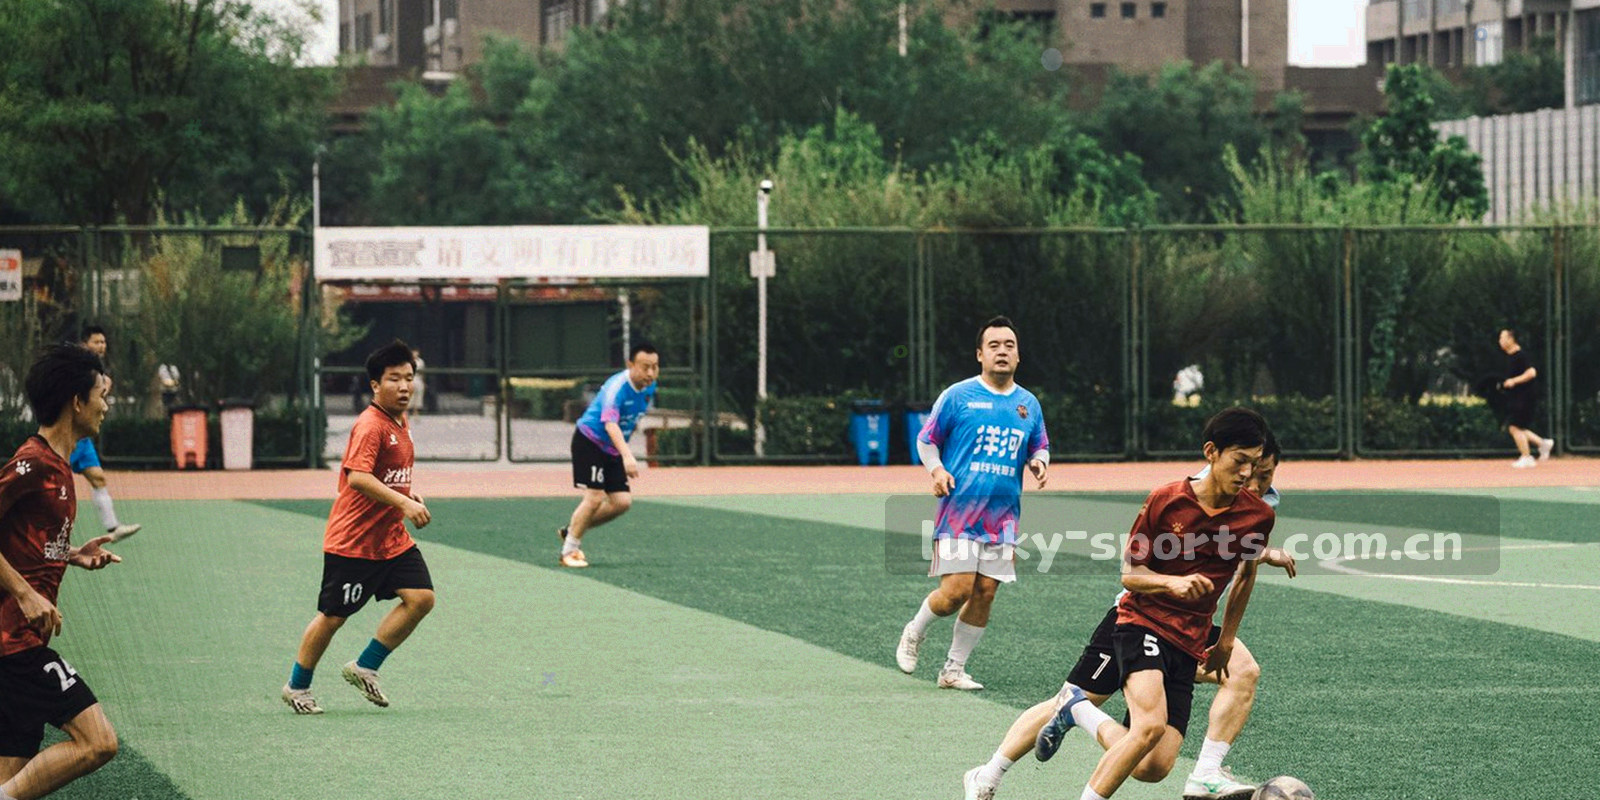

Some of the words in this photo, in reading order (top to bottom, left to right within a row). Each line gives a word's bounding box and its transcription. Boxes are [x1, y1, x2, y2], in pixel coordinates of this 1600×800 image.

[973, 425, 1025, 460] 洋河
[591, 465, 605, 483] 16
[342, 583, 363, 605] 10
[1143, 633, 1160, 657] 5
[1091, 652, 1112, 680] 7
